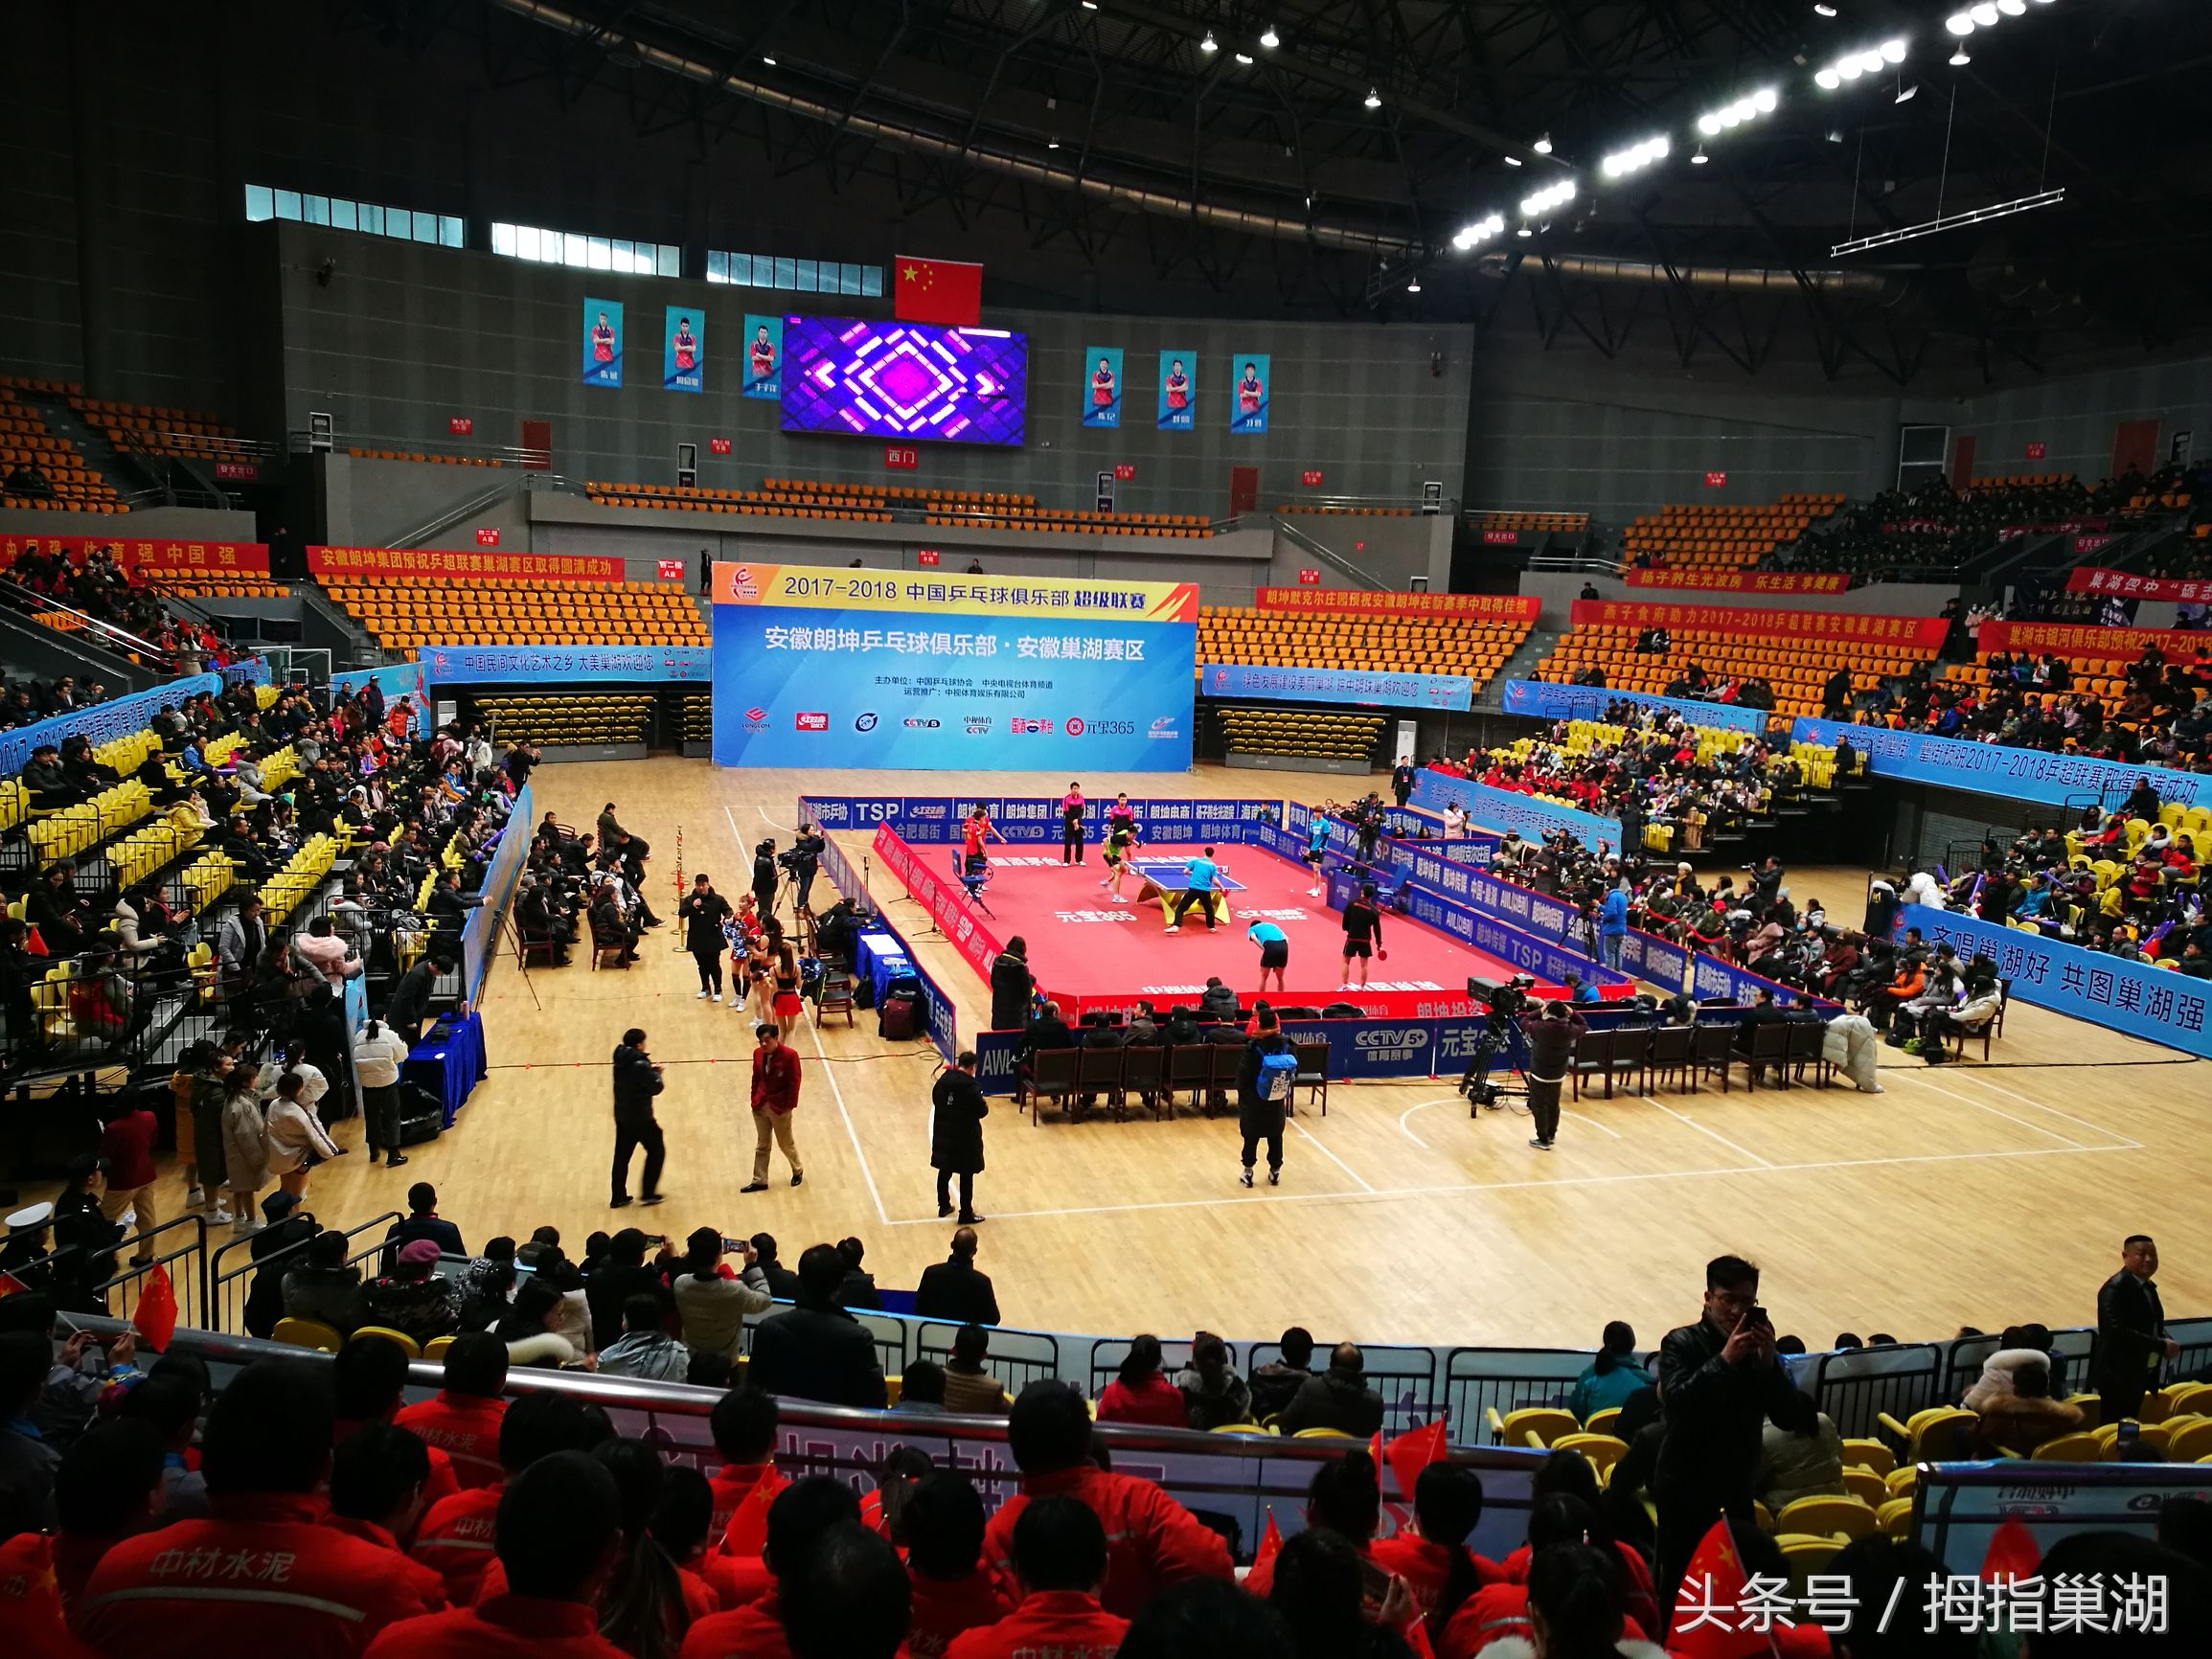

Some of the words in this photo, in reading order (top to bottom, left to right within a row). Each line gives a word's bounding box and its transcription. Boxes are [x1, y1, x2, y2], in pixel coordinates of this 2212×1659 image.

[889, 450, 915, 464] 西门
[167, 543, 236, 565] 中国强
[321, 548, 612, 577] 安徽朗坤集团预祝乒超联赛巢湖赛区取得圆满成功
[786, 577, 898, 600] 2017-2018
[906, 581, 1070, 608] 中国乒乓球俱乐部
[1074, 589, 1147, 610] 超级联赛
[465, 653, 574, 672] 中国民间文化艺术之乡
[578, 653, 655, 672] 大美巢湖欢迎您
[855, 803, 900, 822] TSP
[1005, 805, 1048, 820] 朗坤集团
[1150, 805, 1191, 820] 朗坤电商
[1511, 938, 1543, 971] TSP
[2061, 961, 2206, 1034] 共图巢湖强
[149, 1546, 297, 1585] 中材水泥
